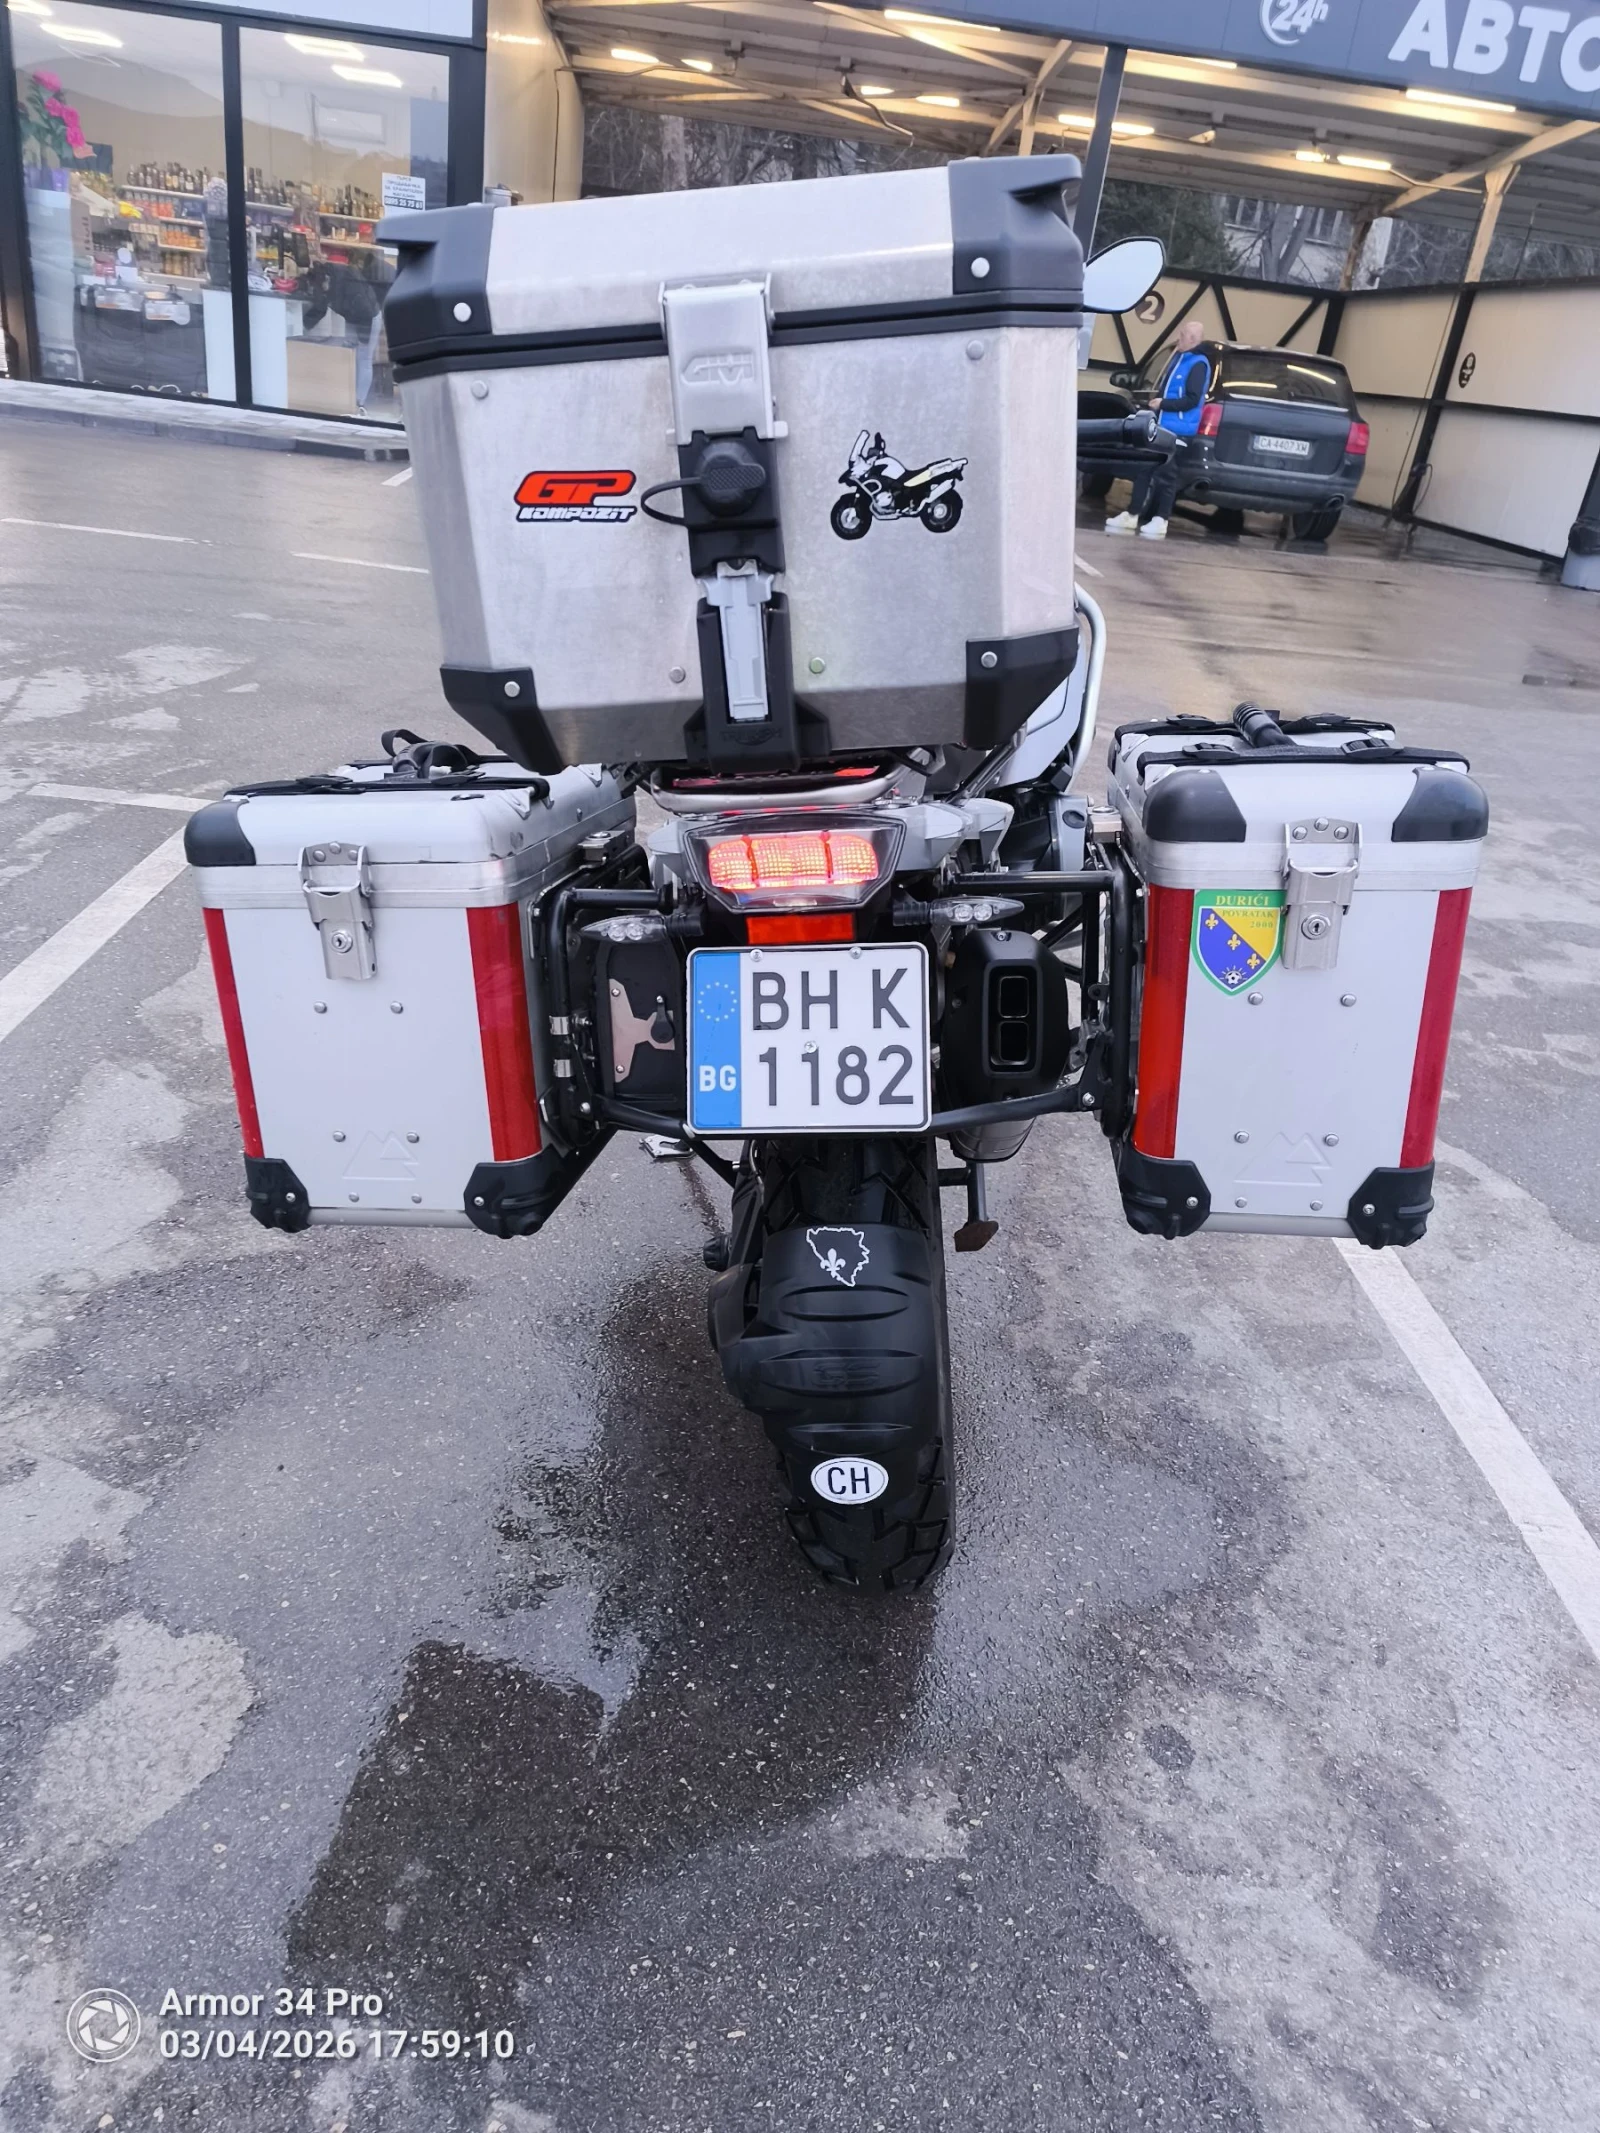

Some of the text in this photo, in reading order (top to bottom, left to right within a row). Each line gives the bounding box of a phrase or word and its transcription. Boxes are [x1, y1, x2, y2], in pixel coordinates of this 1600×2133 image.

[1271, 0, 1329, 33] 24h
[1140, 295, 1159, 321] 2
[515, 471, 635, 505] GP
[1222, 910, 1274, 918] POVRATAK
[753, 968, 911, 1031] BH K
[699, 1064, 737, 1092] BG
[759, 1044, 914, 1106] 1182
[827, 1466, 870, 1495] CH
